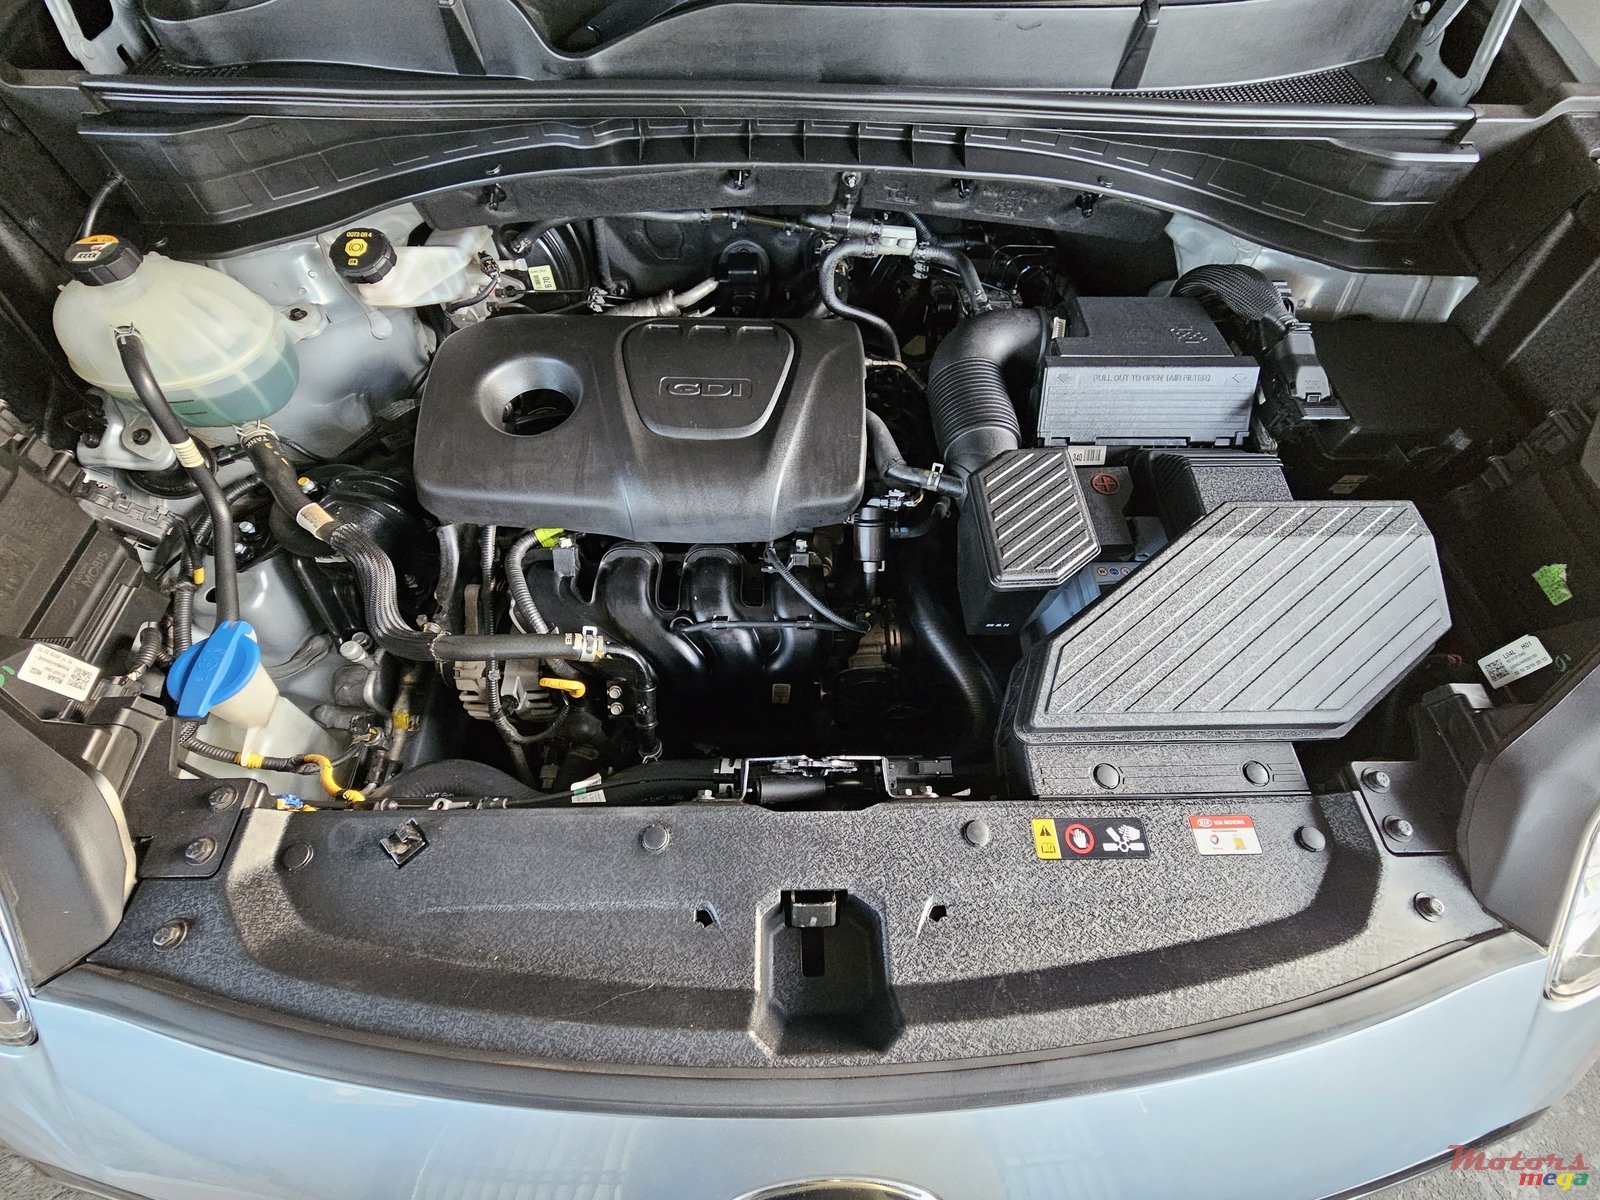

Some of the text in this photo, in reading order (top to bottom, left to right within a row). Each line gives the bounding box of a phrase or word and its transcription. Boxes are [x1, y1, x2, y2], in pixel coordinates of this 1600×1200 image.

[1093, 373, 1112, 382] PULL
[1113, 373, 1129, 382] OUT
[1131, 373, 1142, 382] TO
[1142, 373, 1164, 382] OPEN
[667, 383, 742, 397] GDI
[245, 435, 270, 449] TANK
[81, 551, 109, 588] MOBIS
